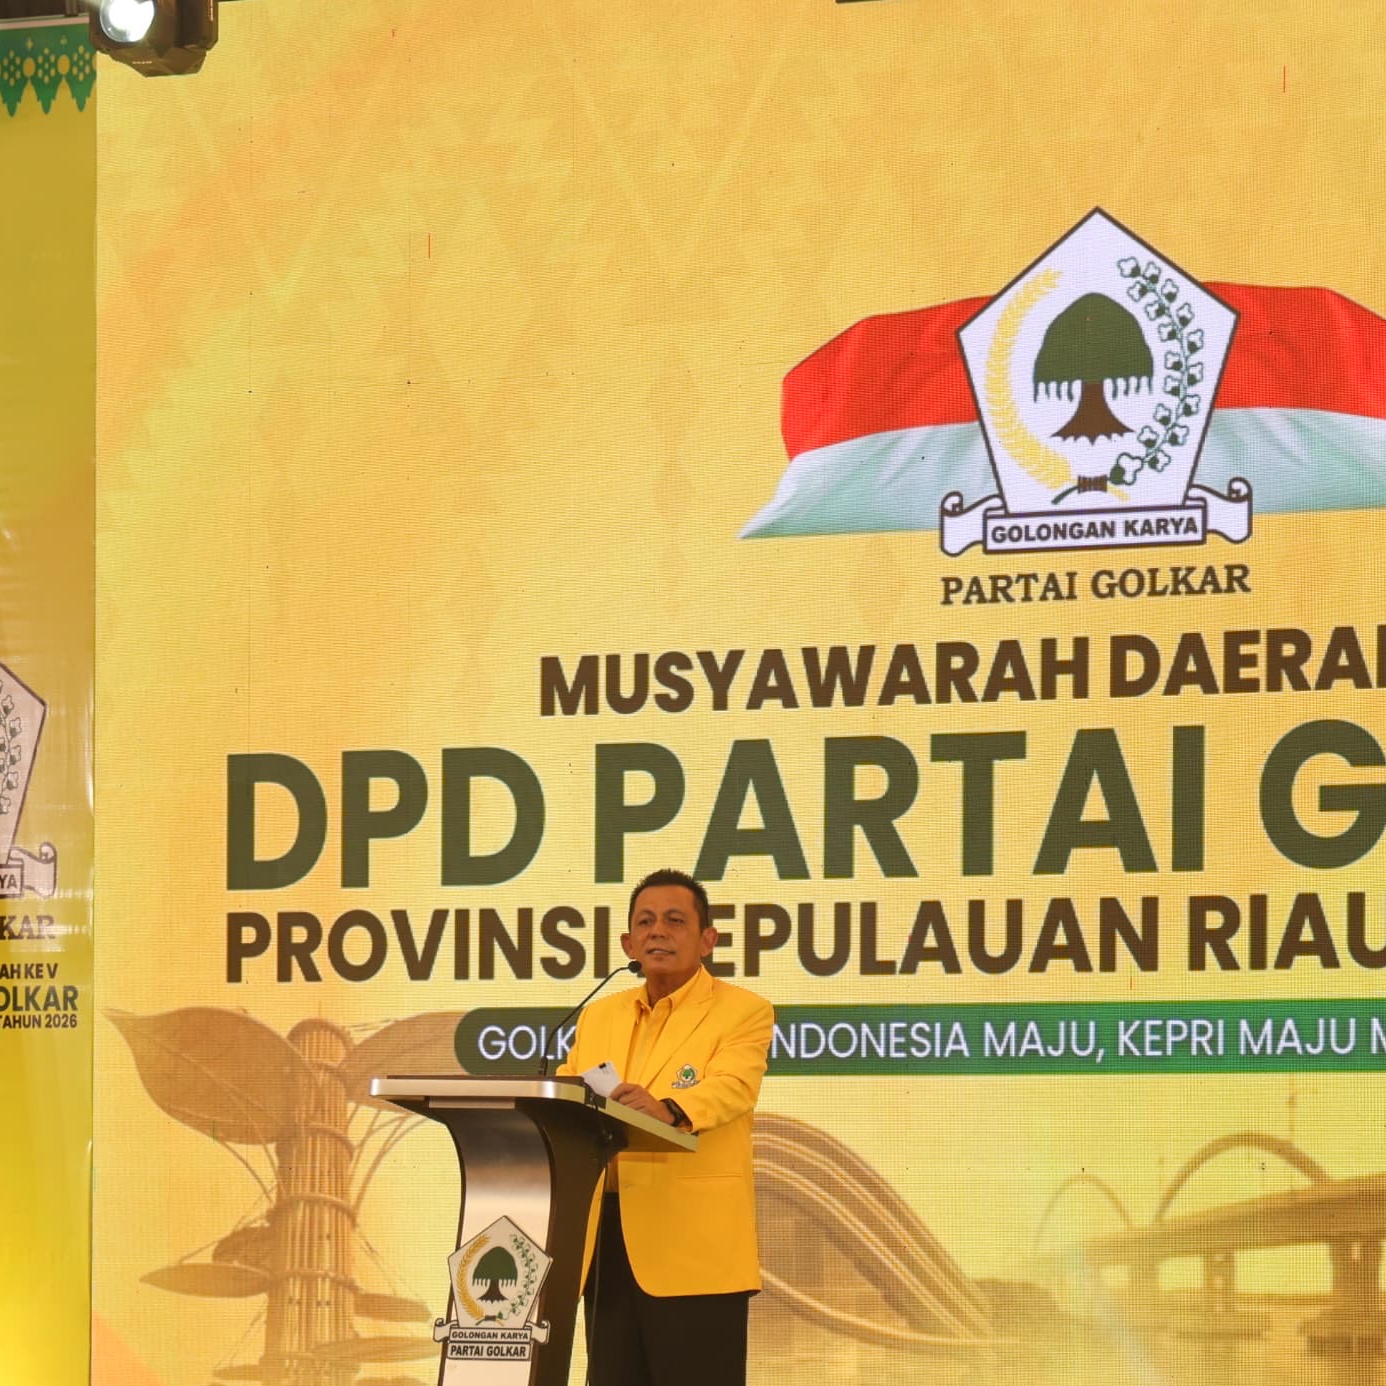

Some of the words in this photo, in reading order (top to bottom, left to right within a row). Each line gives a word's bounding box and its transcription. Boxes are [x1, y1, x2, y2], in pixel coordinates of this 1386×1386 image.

[991, 520, 1114, 544] GOLONGAN
[1124, 517, 1198, 538] KARYA
[940, 571, 1078, 605] PARTAI
[1090, 564, 1252, 599] GOLKAR
[540, 636, 1090, 717] MUSYAWARAH
[225, 746, 546, 891] DPD
[594, 723, 1206, 884] PARTAI
[226, 906, 610, 983] PROVINSI
[637, 895, 1160, 979] EPULAUAN
[24, 963, 44, 979] KE
[47, 963, 59, 979] V
[45, 1013, 78, 1028] 2026
[478, 1026, 577, 1062] GOLK
[771, 1022, 969, 1060] NDONESIA
[984, 1020, 1105, 1063] MAJU,
[1118, 1019, 1224, 1057] KEPRI
[1239, 1017, 1356, 1055] MAJU
[450, 1345, 484, 1357] PARTAI
[486, 1346, 527, 1358] GOLKAR
[452, 1331, 498, 1340] GOLONGAN
[500, 1332, 529, 1340] KARYA
